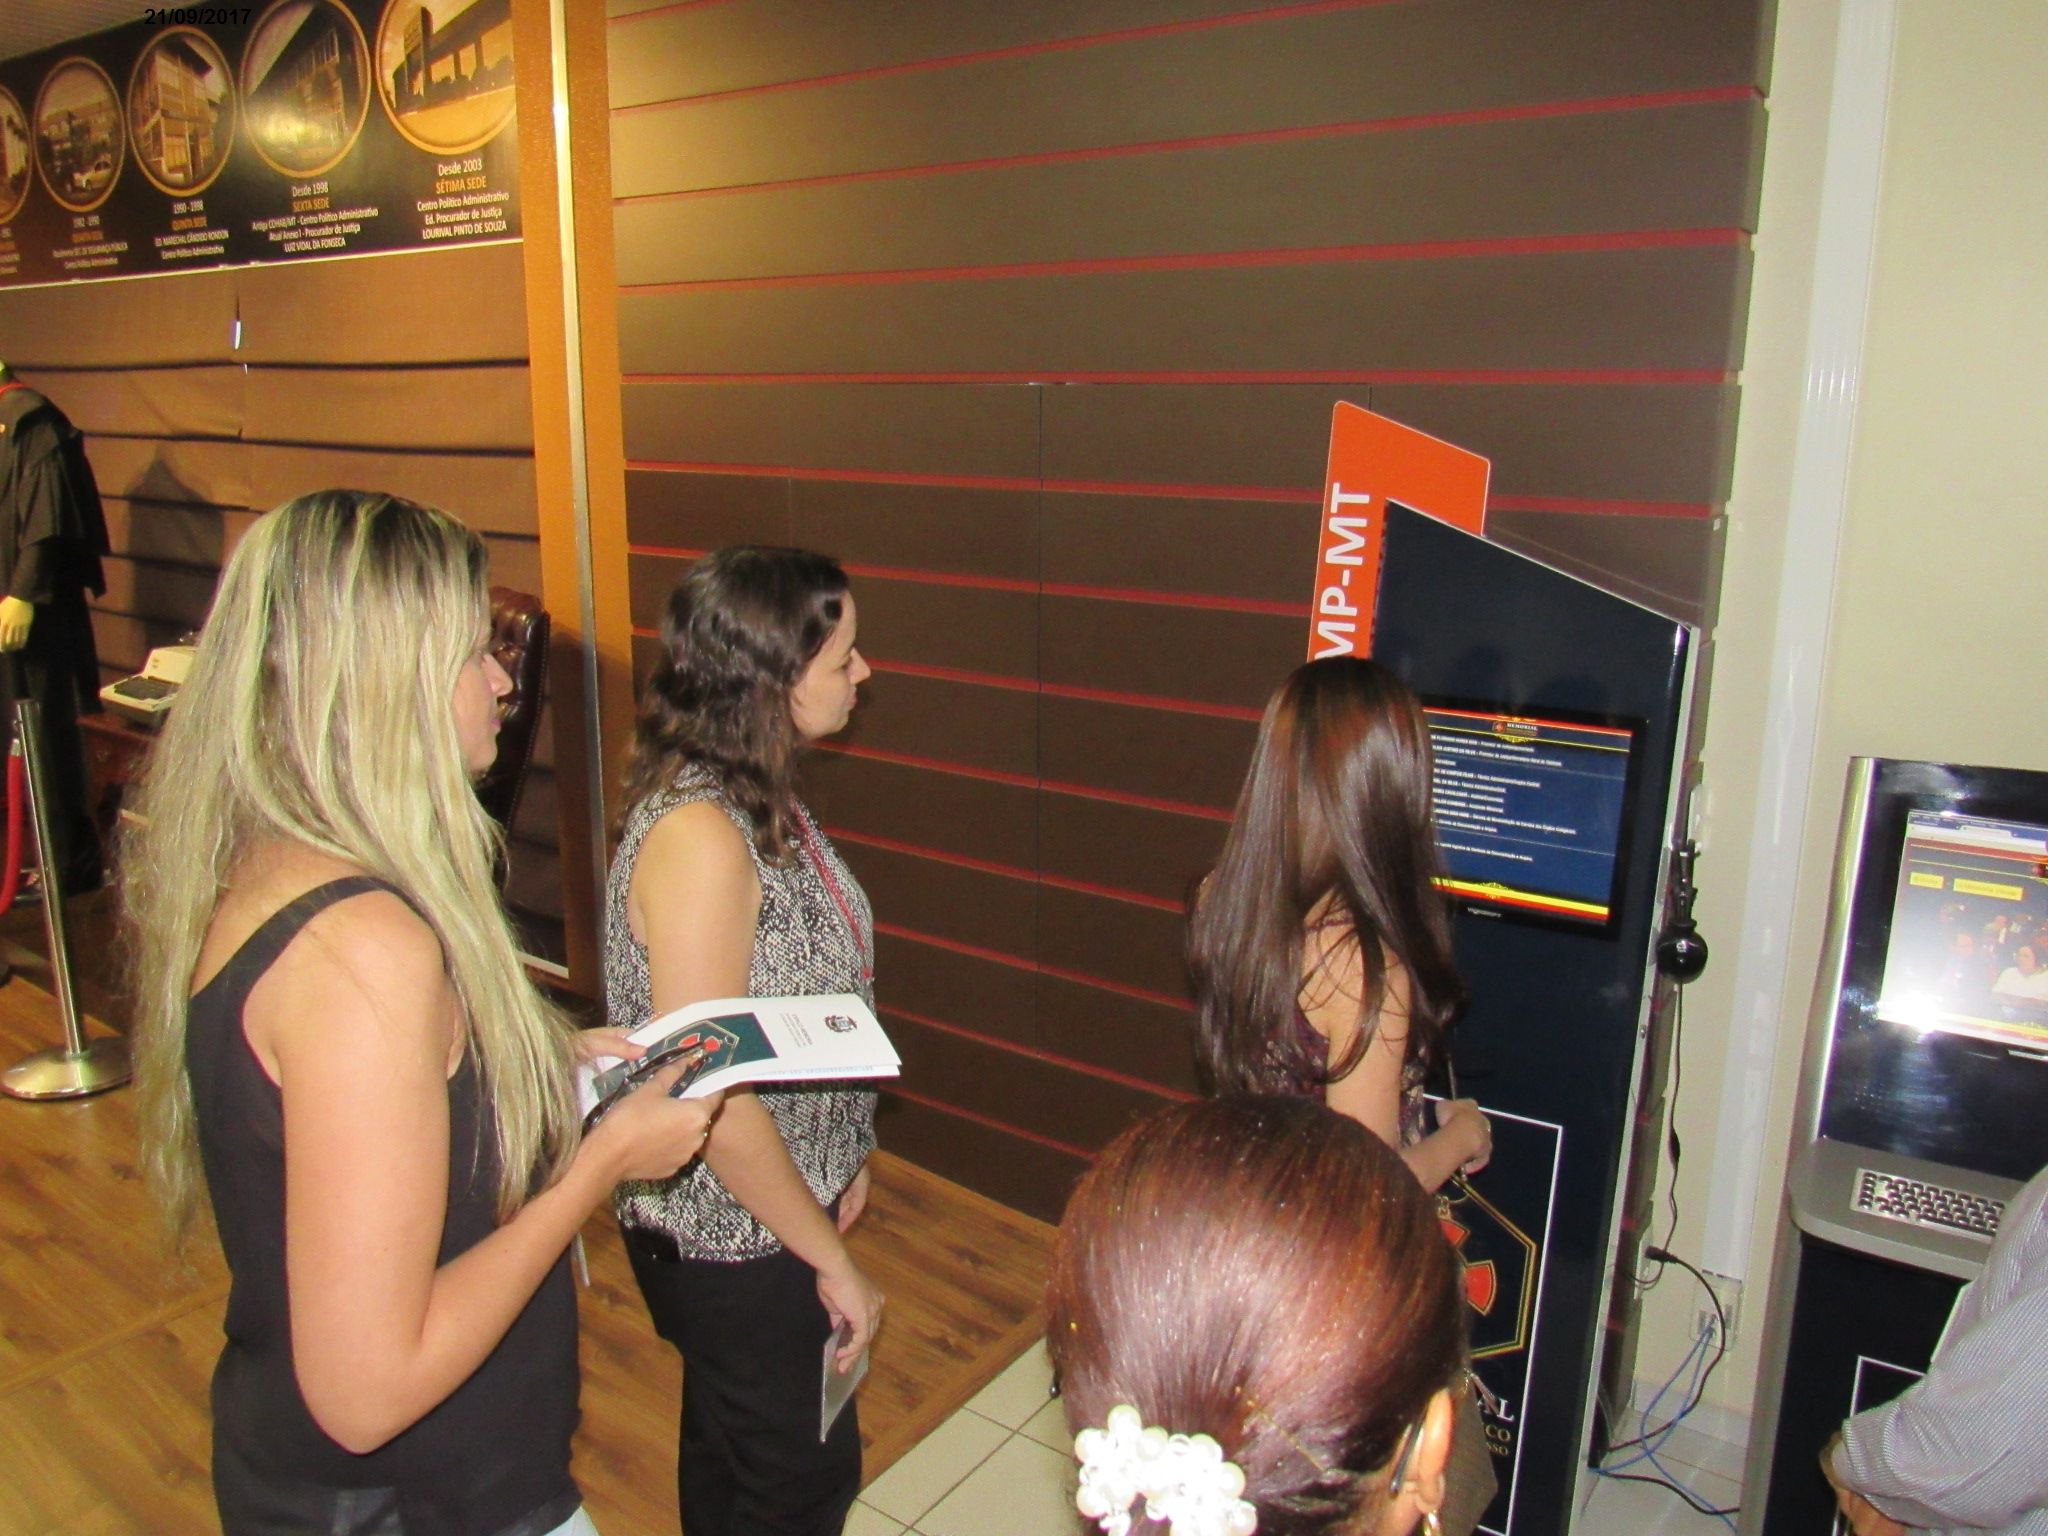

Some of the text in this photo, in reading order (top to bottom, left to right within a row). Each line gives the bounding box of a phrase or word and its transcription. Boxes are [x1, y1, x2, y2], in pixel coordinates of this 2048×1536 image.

[438, 158, 482, 176] Desde 2003
[292, 185, 311, 197] Desde
[436, 175, 487, 194] SÉTIMA SEDE
[292, 197, 330, 212] SEXTA SEDE
[417, 191, 510, 212] Centro Político Administrativo
[300, 215, 318, 225] Centro
[318, 211, 338, 223] Político
[338, 207, 379, 220] Administrativo
[425, 207, 502, 225] Ed. Procurador de Justiça
[305, 226, 333, 237] Procurador
[334, 226, 341, 234] de
[342, 223, 361, 235] Justiça
[423, 220, 507, 240] LOURIVAL PINTO DE SOUZA
[312, 239, 321, 248] DA
[321, 237, 346, 248] FONSECA
[1314, 482, 1370, 660] MP-MT
